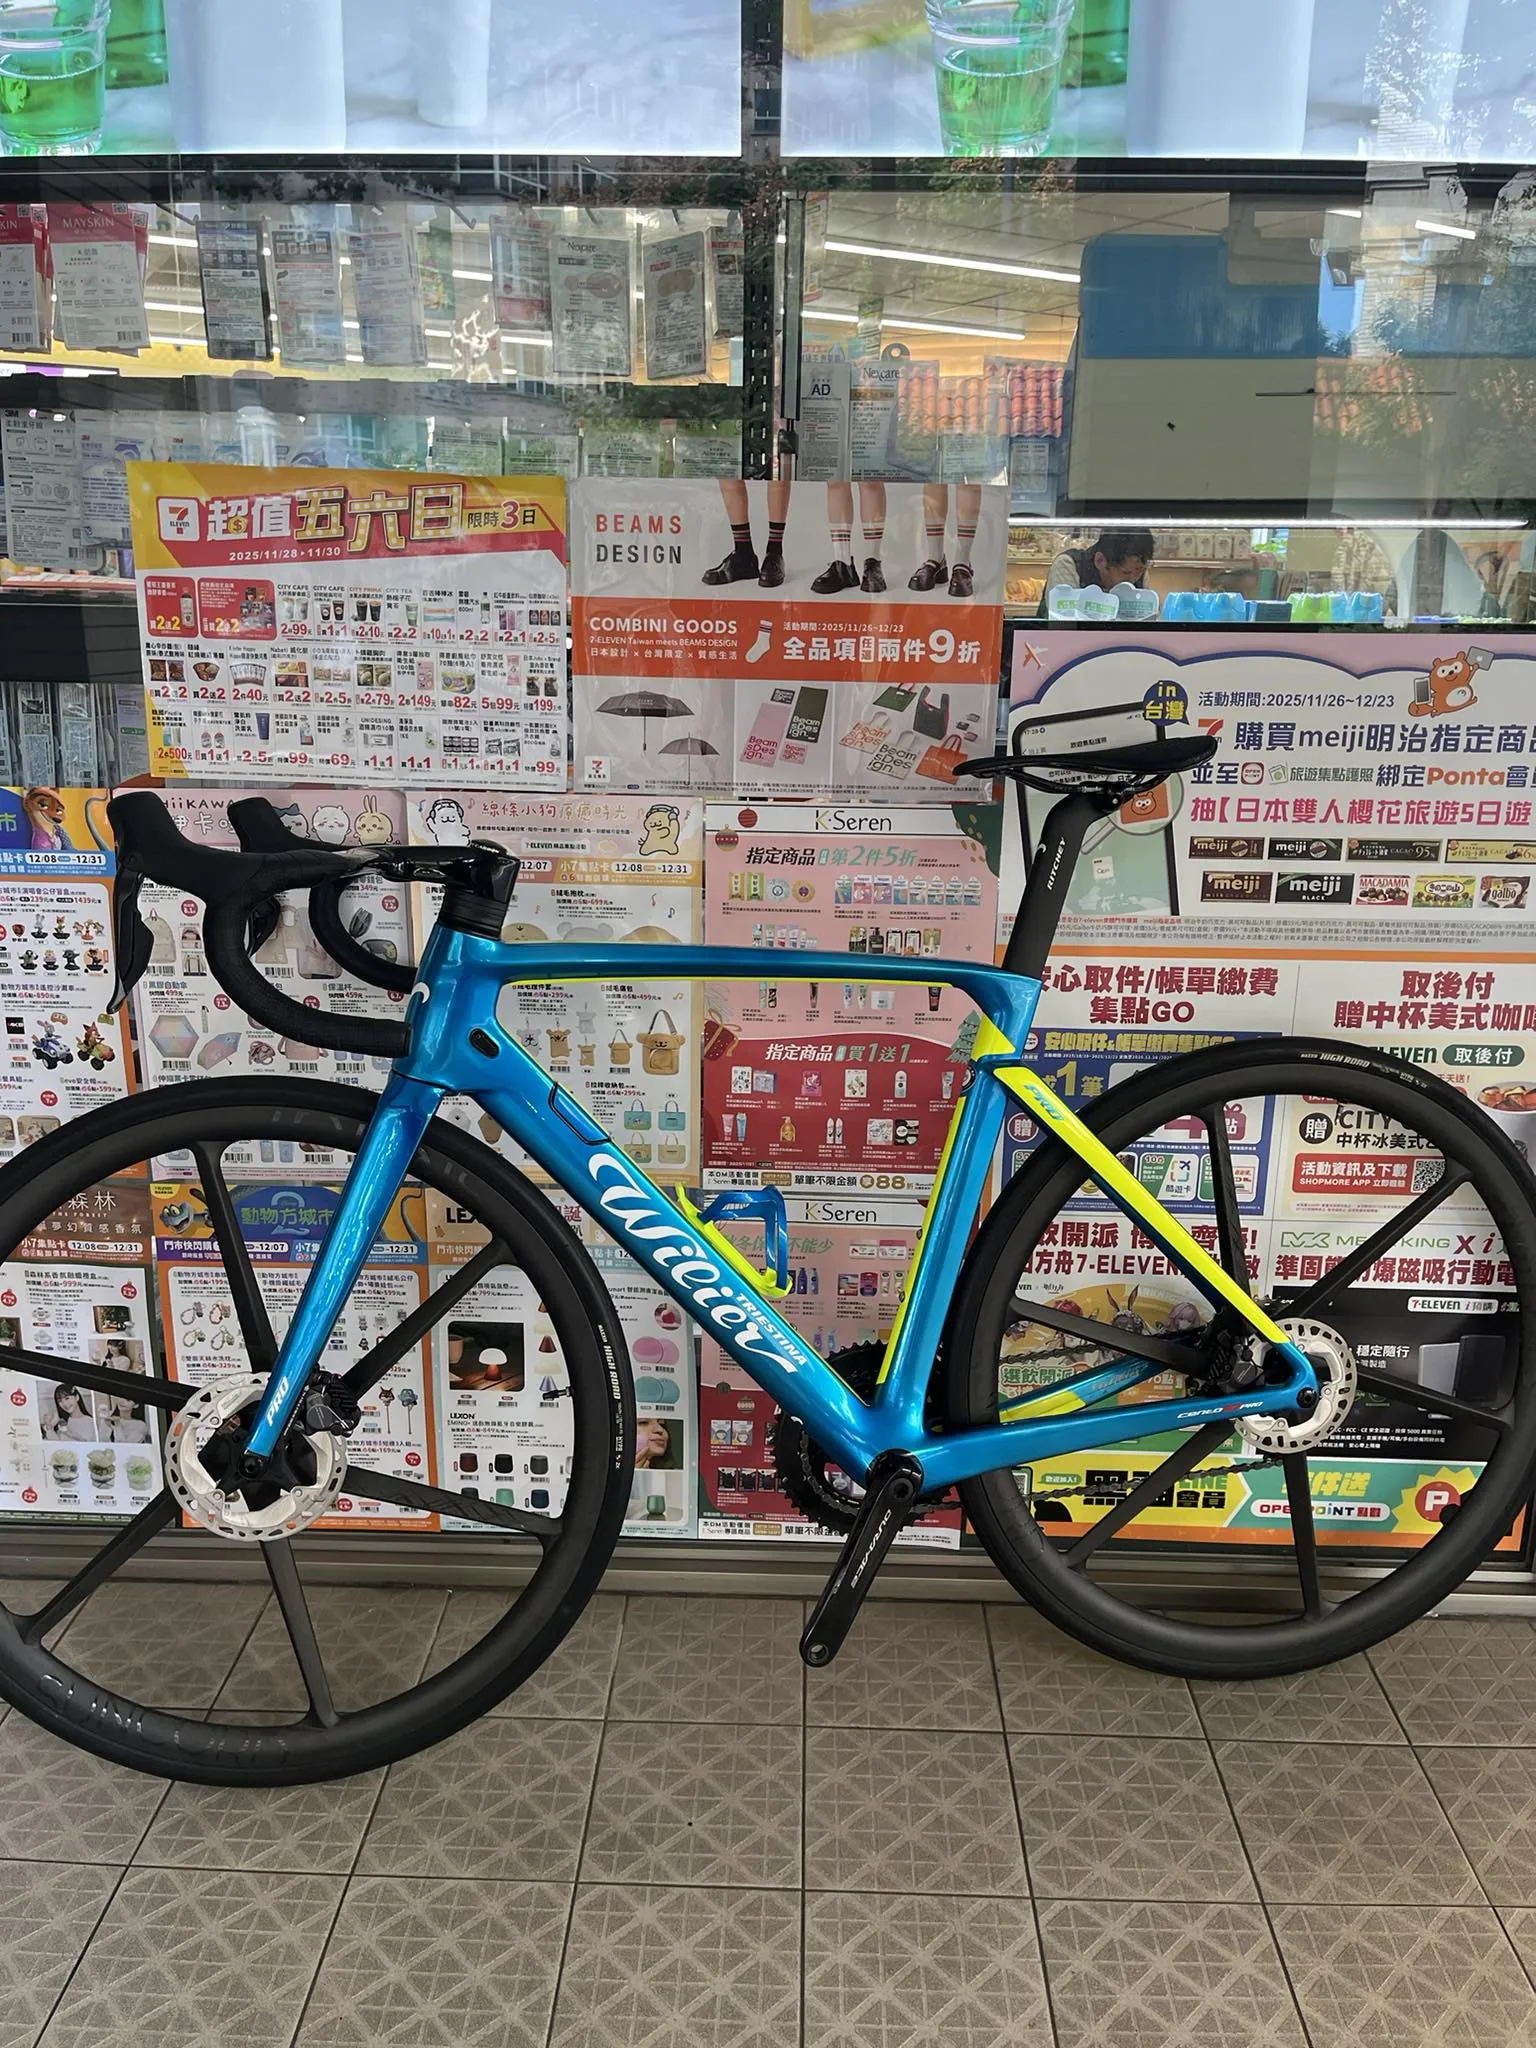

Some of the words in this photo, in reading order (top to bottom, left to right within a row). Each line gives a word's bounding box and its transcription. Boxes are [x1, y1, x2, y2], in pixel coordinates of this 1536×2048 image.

[62, 216, 115, 229] MAYSKIN
[863, 366, 900, 380] Nexcare
[811, 385, 832, 397] AD
[466, 500, 537, 529] 限時3日
[596, 513, 683, 535] BEAMS
[229, 549, 299, 561] 2025/11/28
[307, 546, 341, 557] 11/30
[596, 543, 682, 565] DESIGN
[589, 616, 667, 633] COMBINI
[673, 619, 738, 634] GOODS
[628, 637, 655, 646] Taiwan
[655, 638, 679, 646] meets
[679, 638, 707, 647] BEAMS
[708, 639, 738, 648] DESIGN
[1157, 681, 1176, 697] in
[1198, 690, 1395, 708] 活動期間:2025/11/26~12/23
[1144, 700, 1185, 720] 台灣
[793, 715, 821, 726] Beam
[749, 735, 778, 748] Beam
[879, 744, 917, 761] Beam
[1289, 765, 1374, 783] 旅遊集點護照
[1375, 764, 1536, 789] 綁定Ponta會
[1190, 796, 1533, 827] 抽【日本雙人櫻花旅遊5日遊
[1197, 839, 1228, 853] meiji
[1275, 841, 1307, 854] meiji
[745, 846, 816, 867] 指定商品
[1046, 836, 1068, 892] RITCHEY
[1213, 875, 1260, 894] meiji
[1289, 875, 1342, 896] meiji
[1359, 878, 1409, 888] MACADAMIA
[1490, 886, 1517, 901] galbo
[1400, 970, 1495, 1000] 取後付
[1089, 996, 1195, 1025] 集點GO
[764, 1043, 833, 1062] 指定商品
[1454, 1047, 1514, 1065] 取後付
[1305, 1118, 1328, 1141] 贈
[1300, 1160, 1408, 1178] 活動資訊及下載
[794, 1175, 857, 1187] 單筆不限金額
[1299, 1177, 1351, 1186] SHOPMORE
[1352, 1179, 1372, 1187] APP
[587, 1152, 798, 1375] Wilier
[735, 1292, 808, 1367] TRIESTINA
[1355, 1344, 1411, 1359] 穩定隨行
[266, 1375, 290, 1427] PRO
